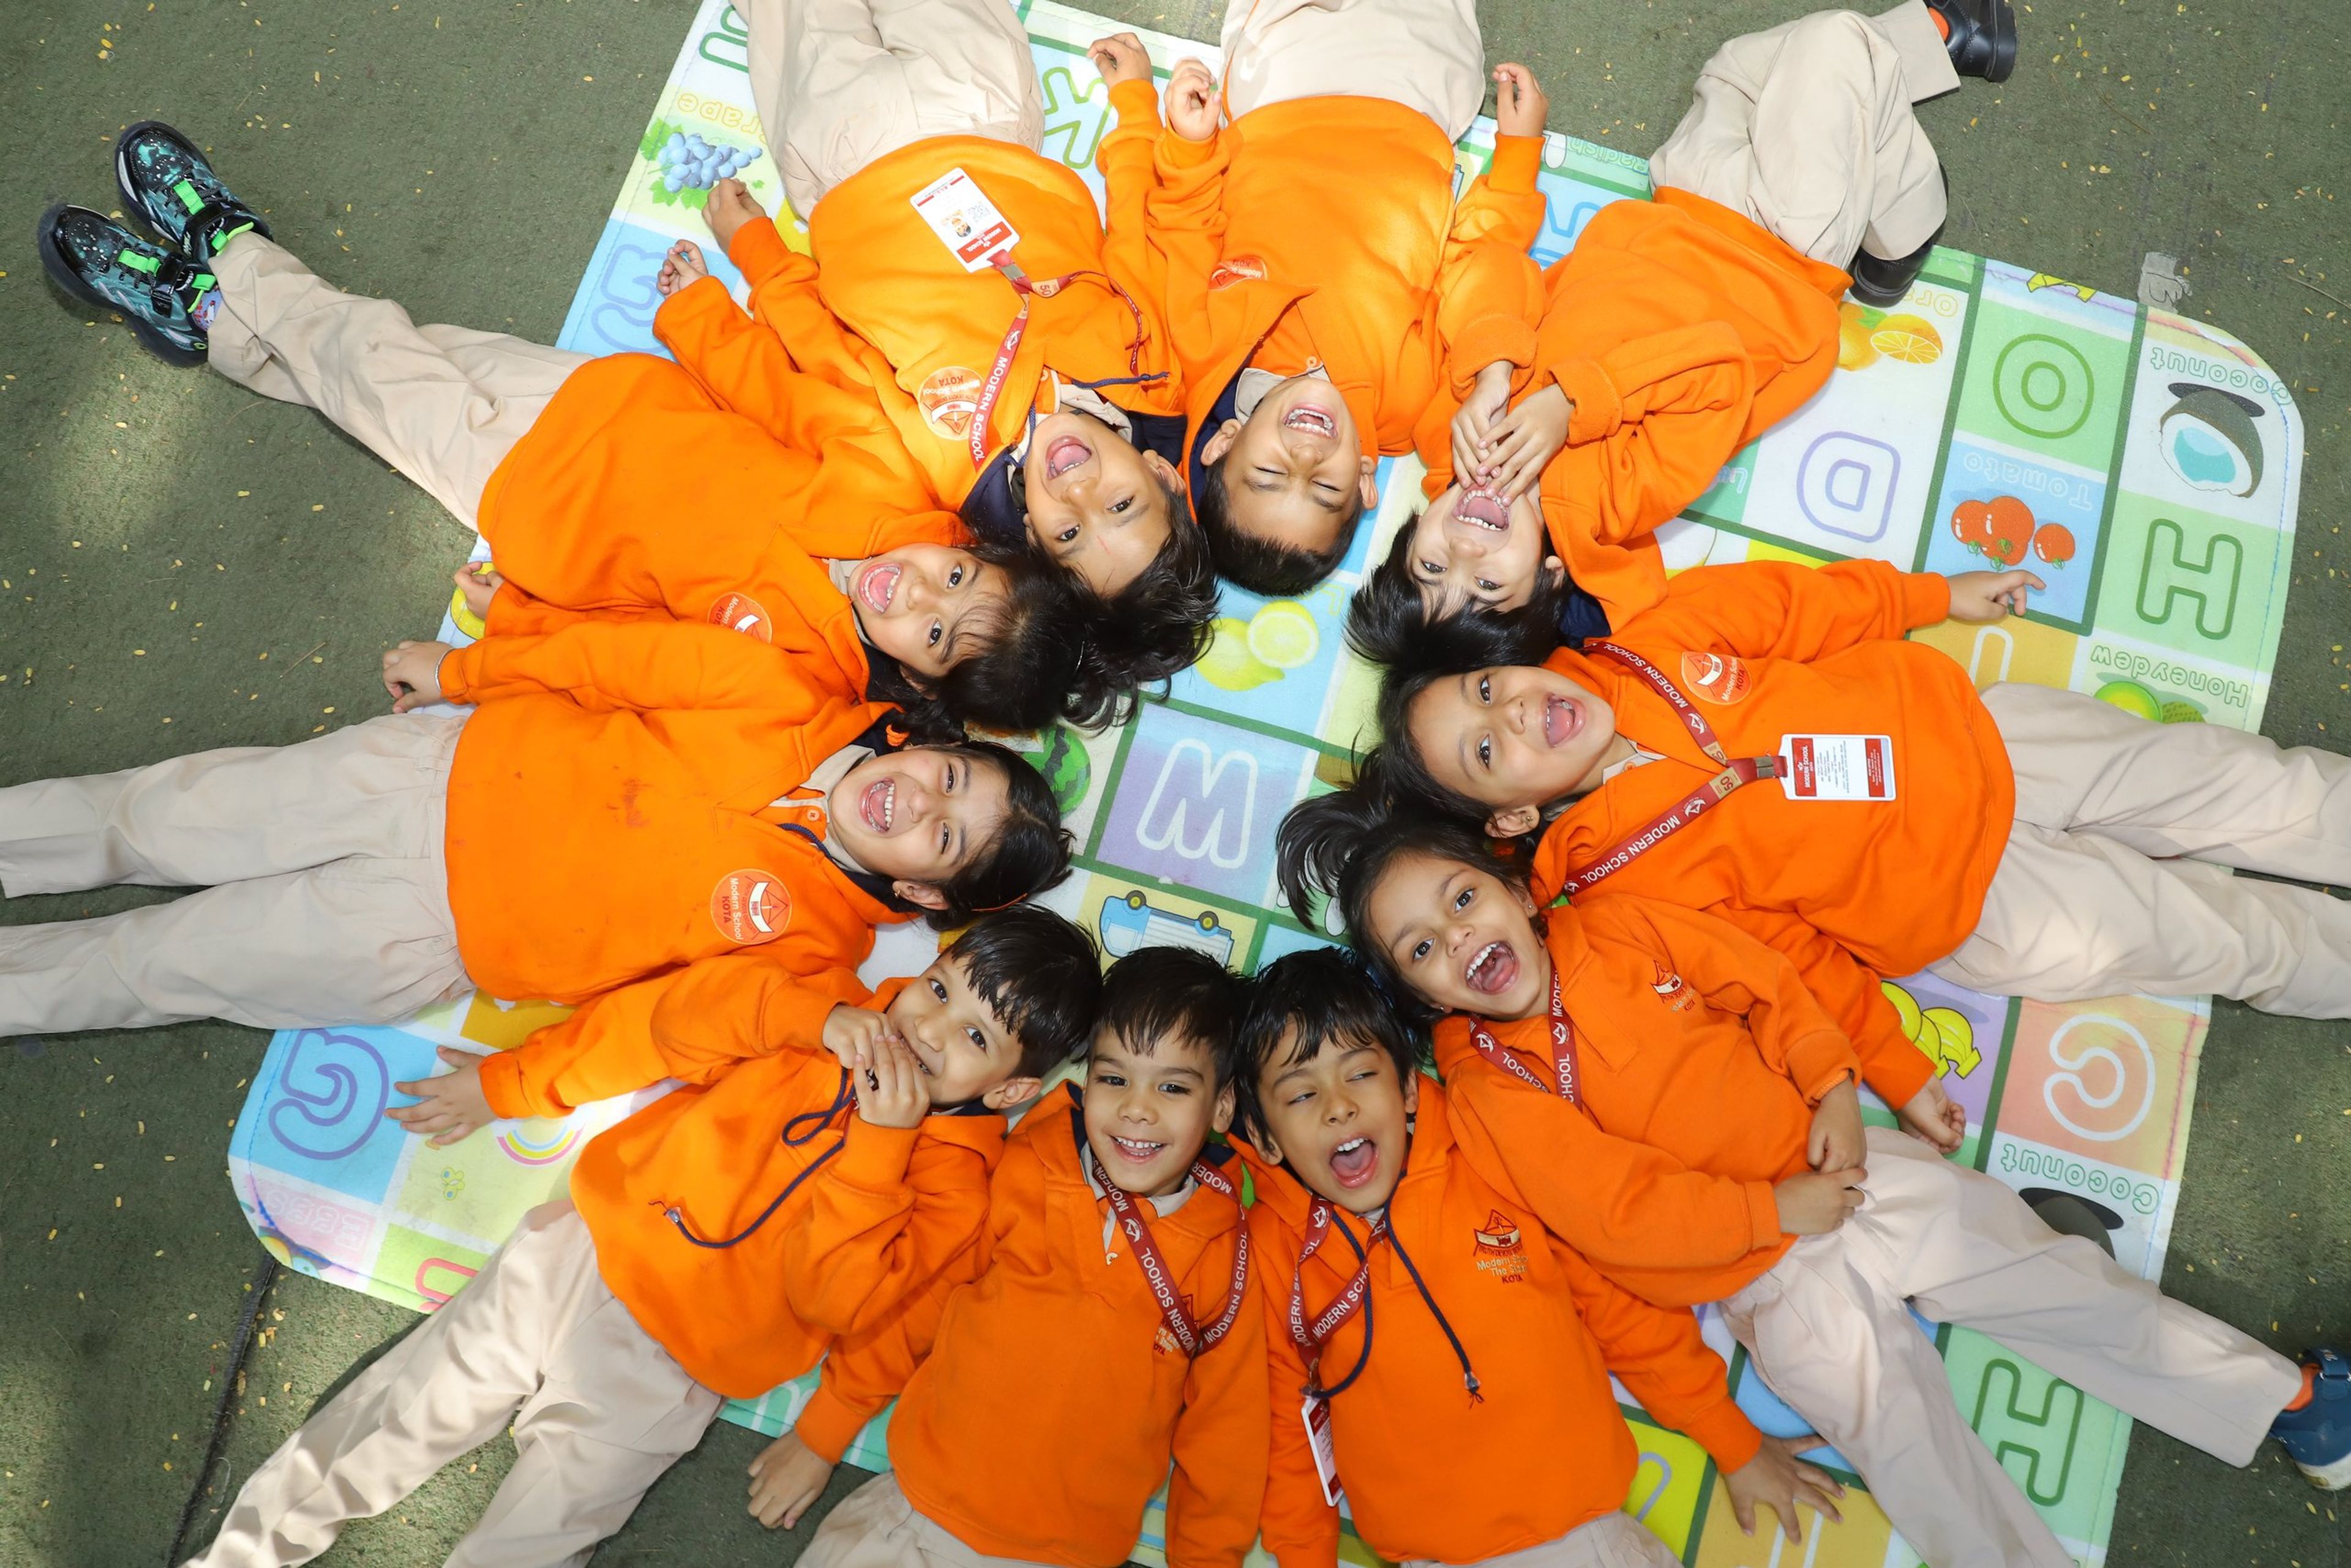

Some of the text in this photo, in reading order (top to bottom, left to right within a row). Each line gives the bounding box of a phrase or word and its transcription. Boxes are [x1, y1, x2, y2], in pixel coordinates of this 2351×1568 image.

[677, 92, 767, 144] rape
[1040, 284, 1052, 296] 50
[937, 375, 964, 387] KOTA
[1993, 334, 2094, 439] O
[2150, 346, 2293, 405] Coconut
[970, 356, 1008, 462] MODERN SCHOOL
[1797, 431, 1900, 544] D
[1964, 451, 2093, 511] Tomato
[2136, 519, 2243, 640] H
[713, 606, 725, 625] KOT
[722, 596, 739, 625] Modern
[1603, 643, 1688, 708] MODERN SCHOOL
[1721, 673, 1736, 702] Modern
[1735, 670, 1745, 691] KOTA
[2090, 645, 2249, 709] Honeydew
[1720, 776, 1734, 791] 50
[1580, 814, 1681, 884] MODERN SCHOOL
[722, 896, 731, 923] KOTA
[730, 877, 744, 940] Modern School
[268, 1029, 389, 1160] G
[1559, 1053, 1575, 1103] CHOOL
[1191, 1161, 1232, 1194] MODER
[2000, 1142, 2160, 1215] Coconut
[1141, 1247, 1174, 1308] SCHOOL
[1204, 1231, 1247, 1344] MODERN SCHOOL
[1501, 1274, 1523, 1284] KOTA
[1313, 1300, 1351, 1341] MODERN
